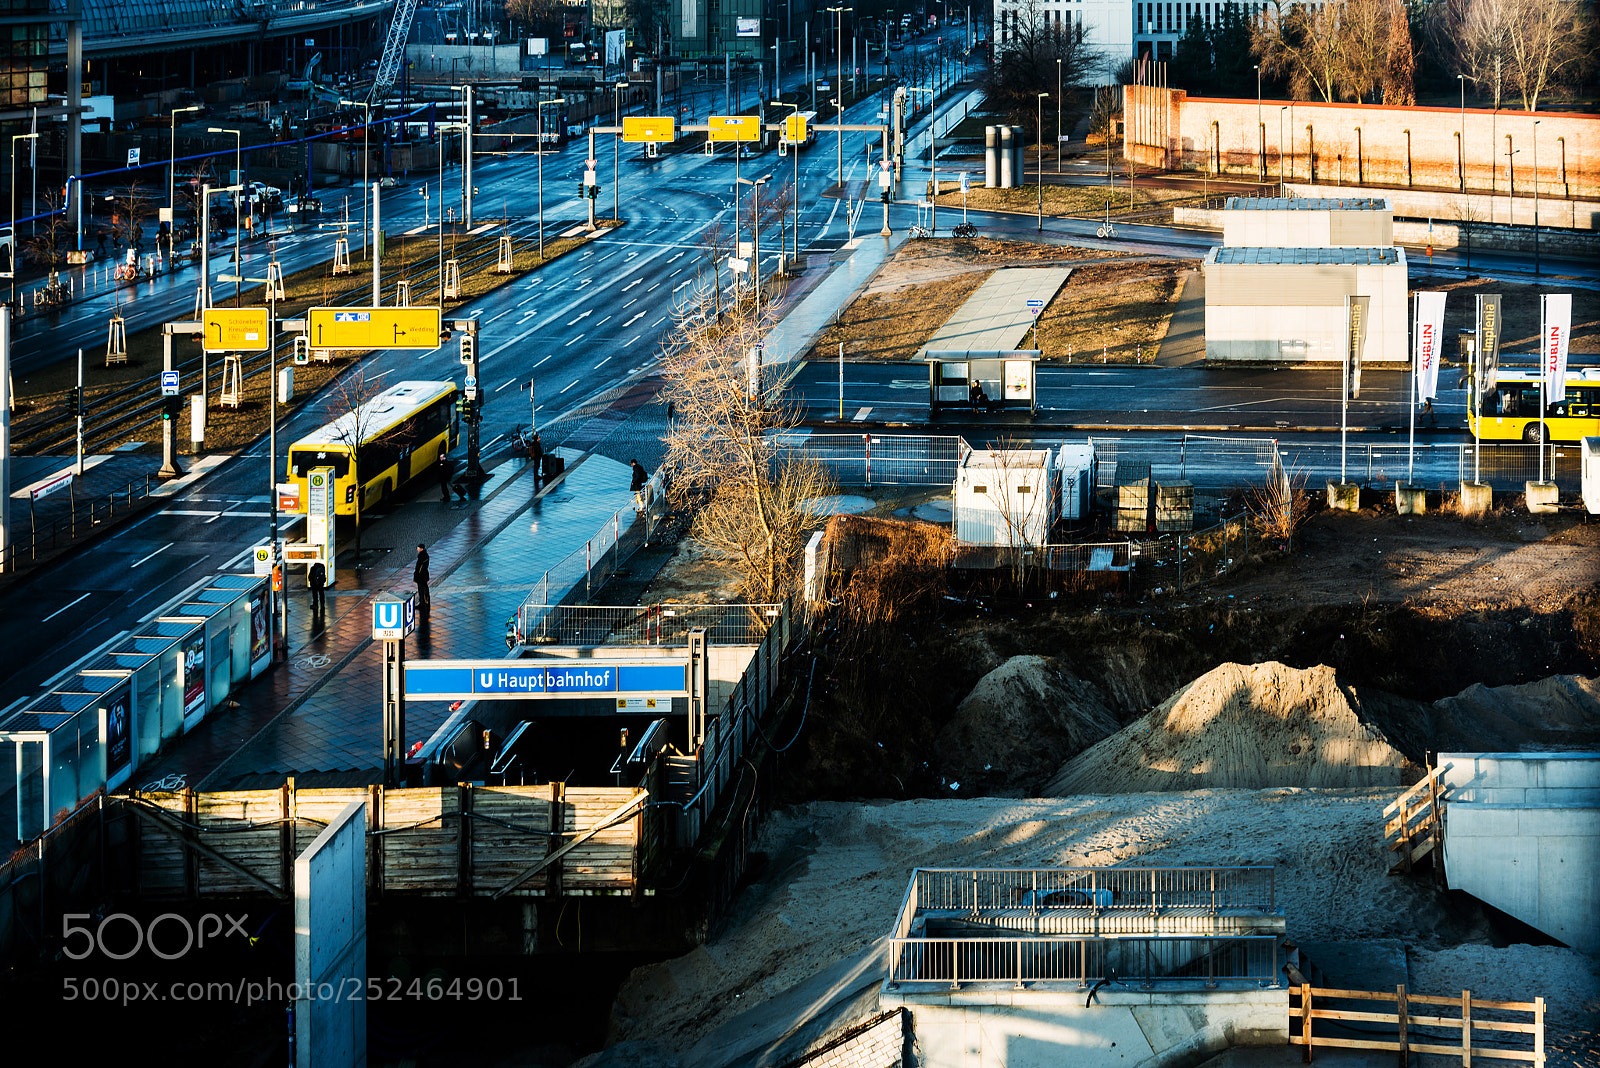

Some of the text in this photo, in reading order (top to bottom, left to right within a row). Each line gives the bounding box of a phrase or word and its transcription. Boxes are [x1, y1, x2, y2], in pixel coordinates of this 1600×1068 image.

[1482, 304, 1496, 352] Implenia
[379, 604, 398, 628] U
[480, 671, 610, 691] U Hauptbahnhof
